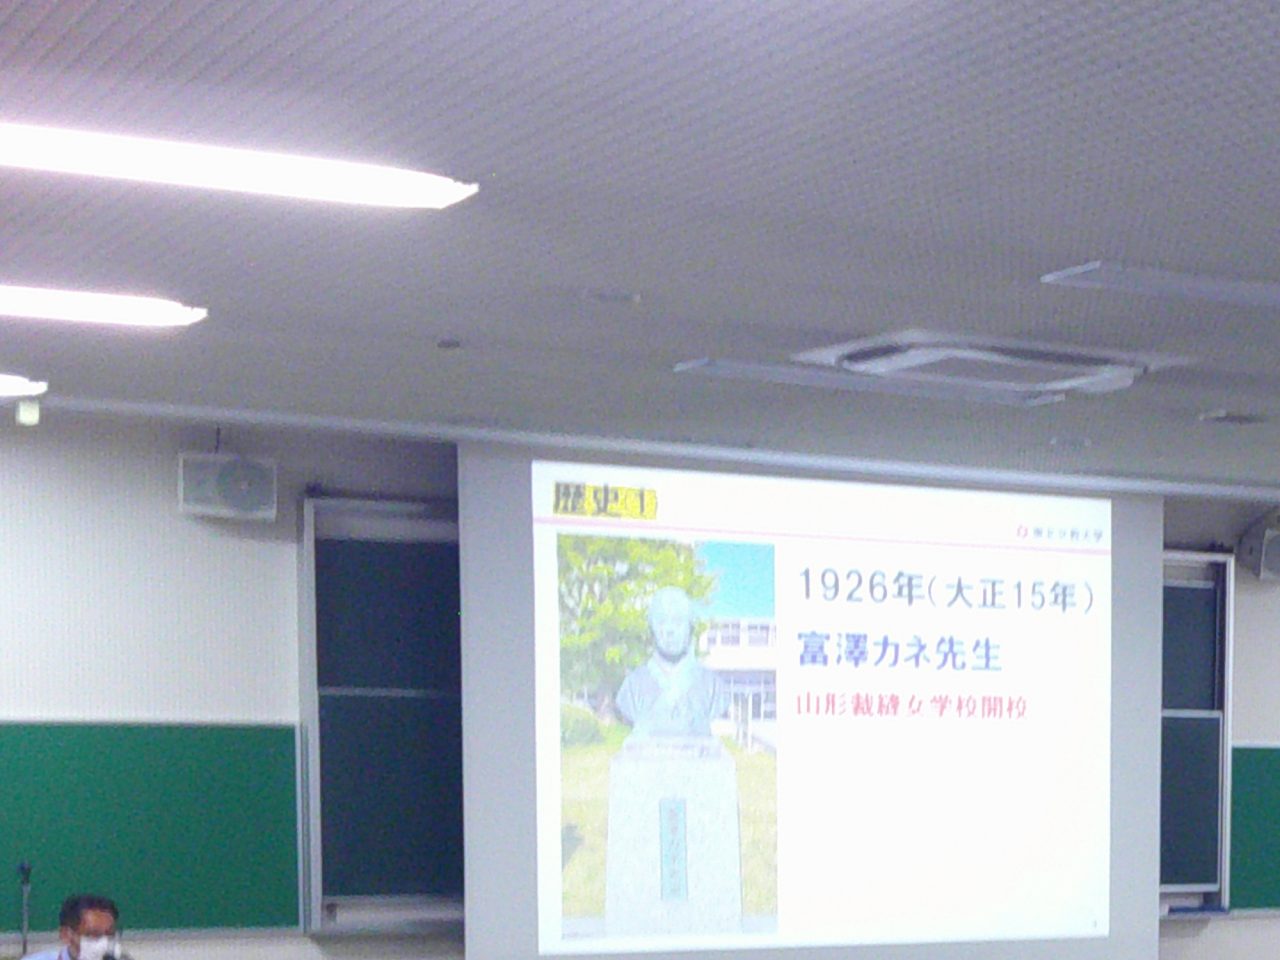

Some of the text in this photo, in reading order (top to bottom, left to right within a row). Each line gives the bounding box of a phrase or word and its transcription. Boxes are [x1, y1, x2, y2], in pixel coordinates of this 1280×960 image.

[799, 567, 1094, 614] 1926年(大正15年)
[797, 630, 1002, 671] 富澤カネ先生
